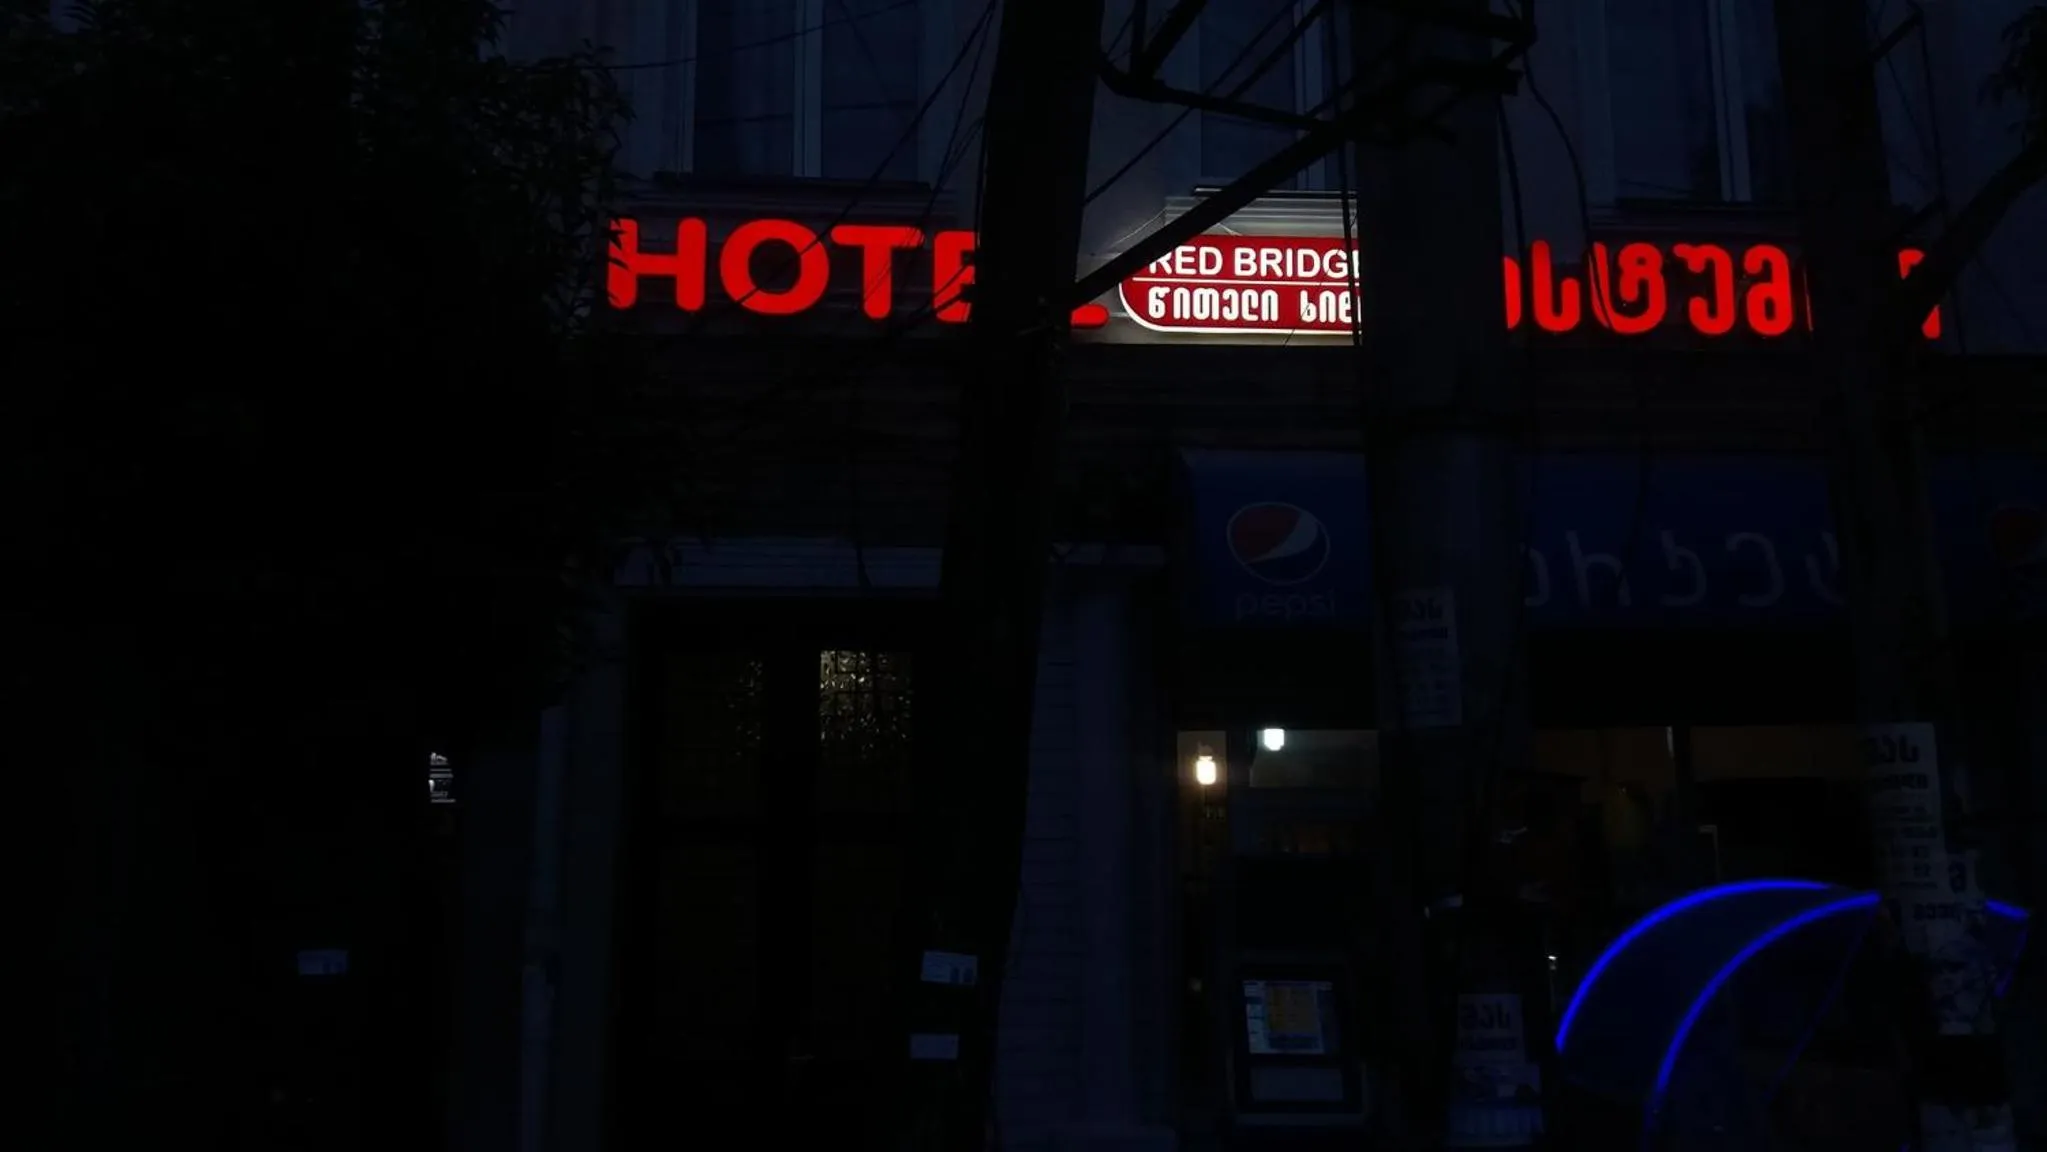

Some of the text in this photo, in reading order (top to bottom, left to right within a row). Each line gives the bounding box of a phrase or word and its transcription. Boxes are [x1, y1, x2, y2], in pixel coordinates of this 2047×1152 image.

[1149, 245, 1223, 275] RED
[1148, 286, 1279, 322] წითელი
[1236, 588, 1334, 622] pepsi
